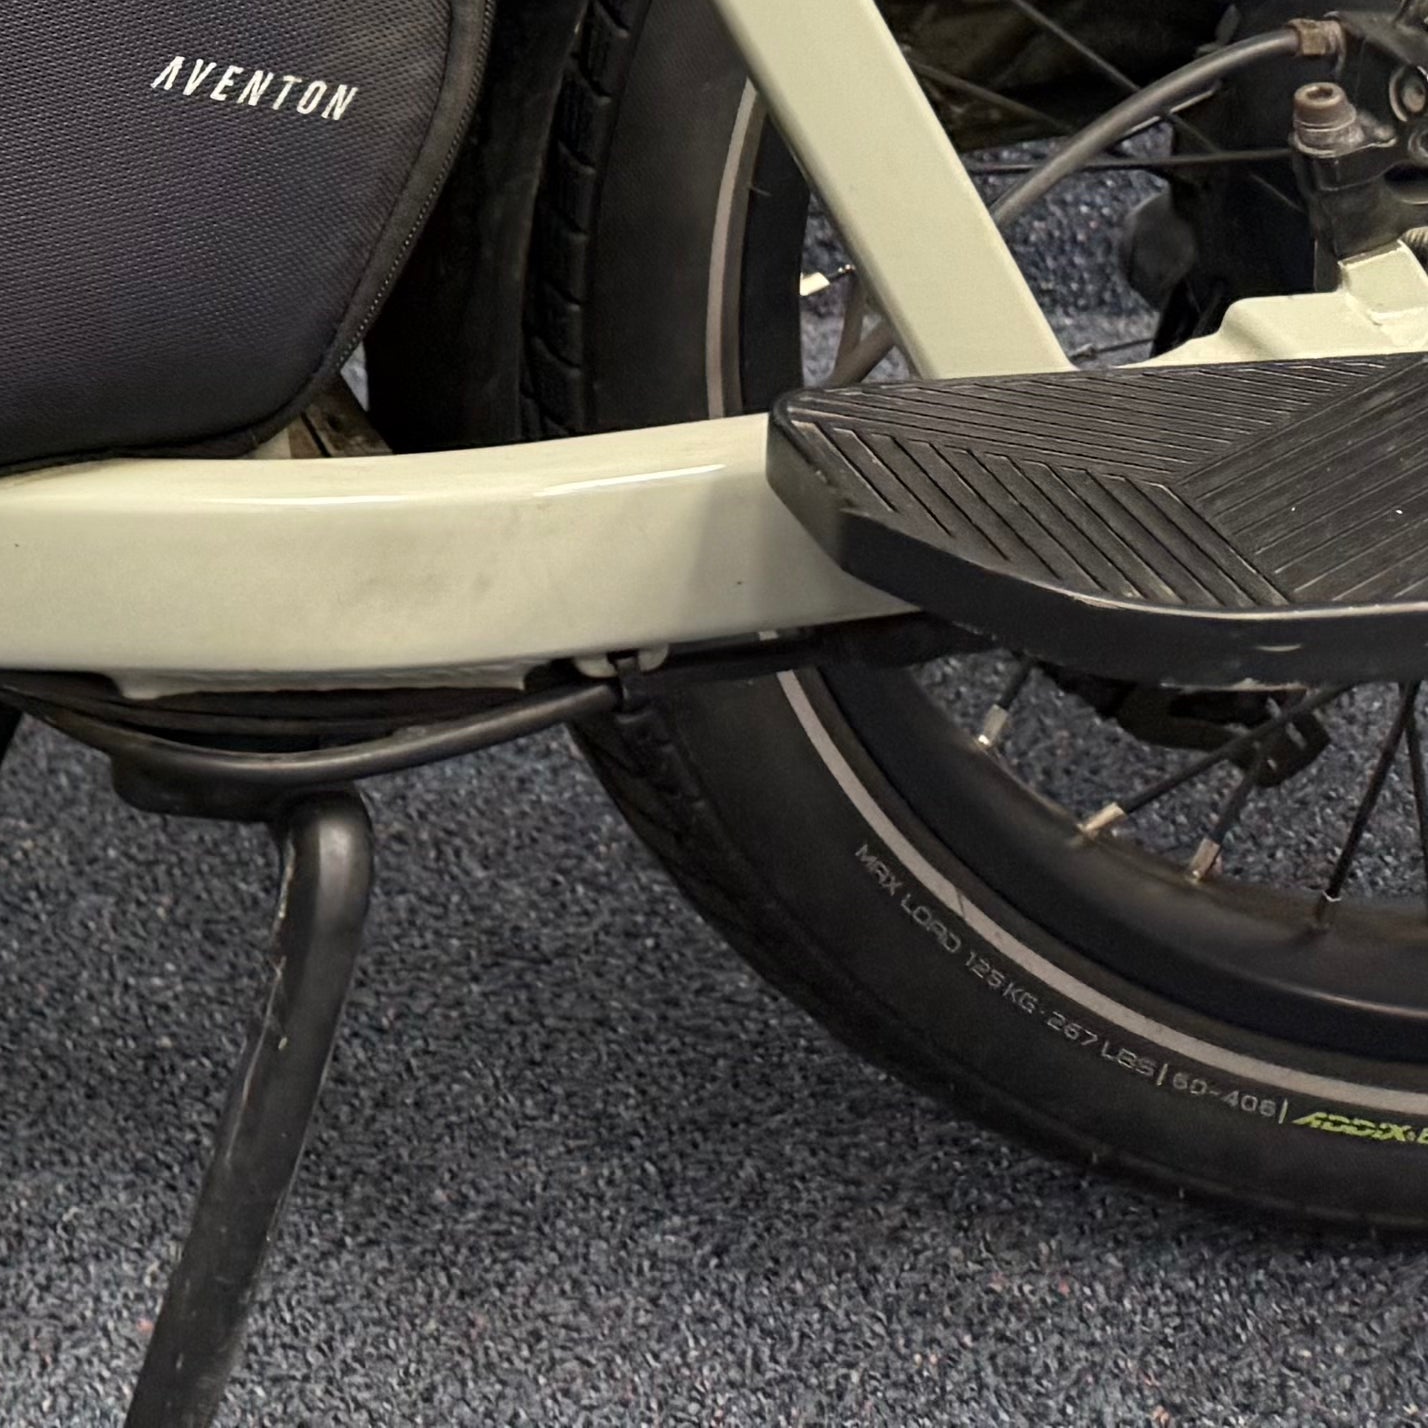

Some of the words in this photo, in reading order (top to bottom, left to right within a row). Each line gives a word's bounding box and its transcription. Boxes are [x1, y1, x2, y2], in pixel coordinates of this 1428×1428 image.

[150, 55, 359, 121] AVENTON
[855, 843, 903, 896] MAX
[900, 893, 962, 954] LOAD
[1046, 1010, 1099, 1046] 267
[1100, 1040, 1156, 1077] LBS
